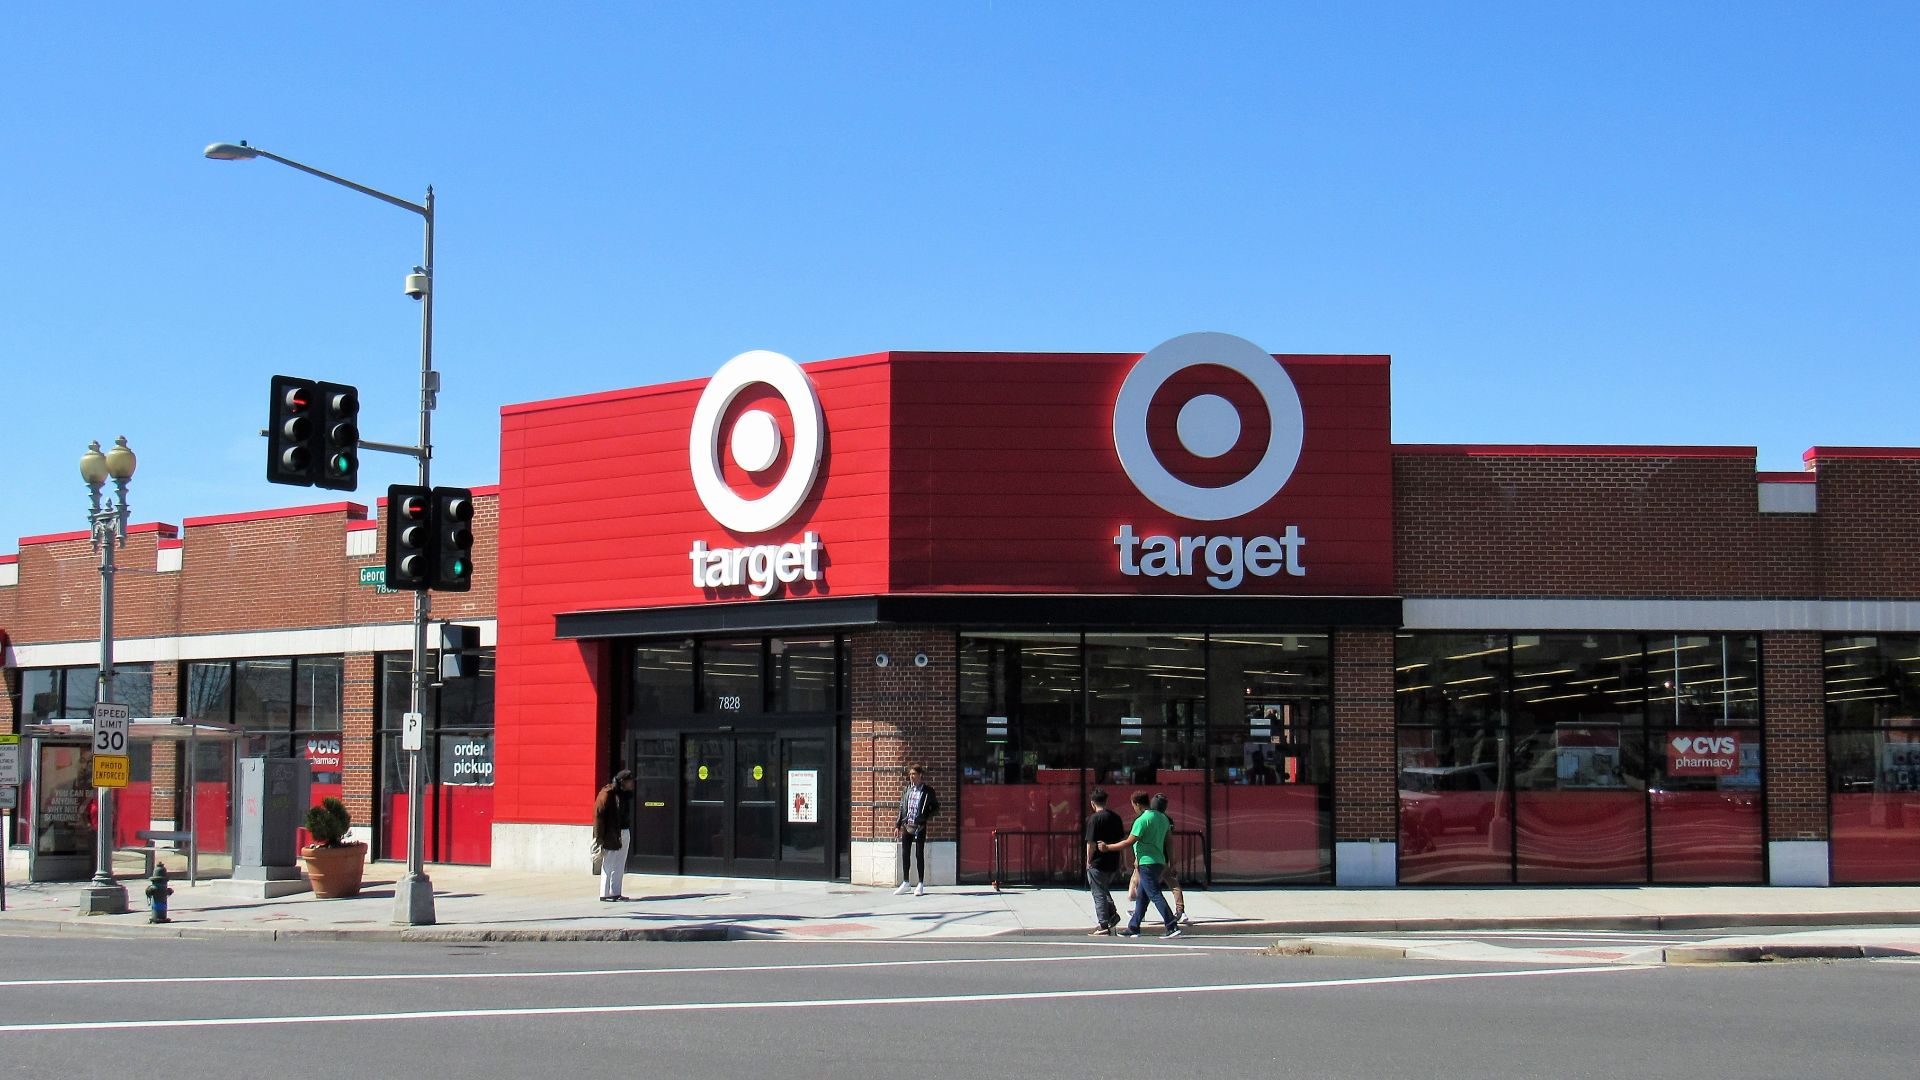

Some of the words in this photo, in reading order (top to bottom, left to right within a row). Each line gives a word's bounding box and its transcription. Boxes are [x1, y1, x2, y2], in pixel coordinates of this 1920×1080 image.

[689, 531, 823, 597] target
[1113, 524, 1306, 590] target
[360, 568, 386, 583] Georg
[376, 584, 399, 594] 78
[718, 696, 741, 710] 7828
[97, 708, 127, 719] SPEED
[100, 720, 123, 729] LIMIT
[96, 730, 124, 751] 30
[317, 739, 340, 755] CVS
[454, 740, 485, 756] order
[1692, 736, 1735, 754] CVS
[100, 761, 123, 770] PHOTO
[453, 758, 493, 777] pickup
[1675, 756, 1733, 769] pharmacy
[95, 771, 125, 780] ENFORCED
